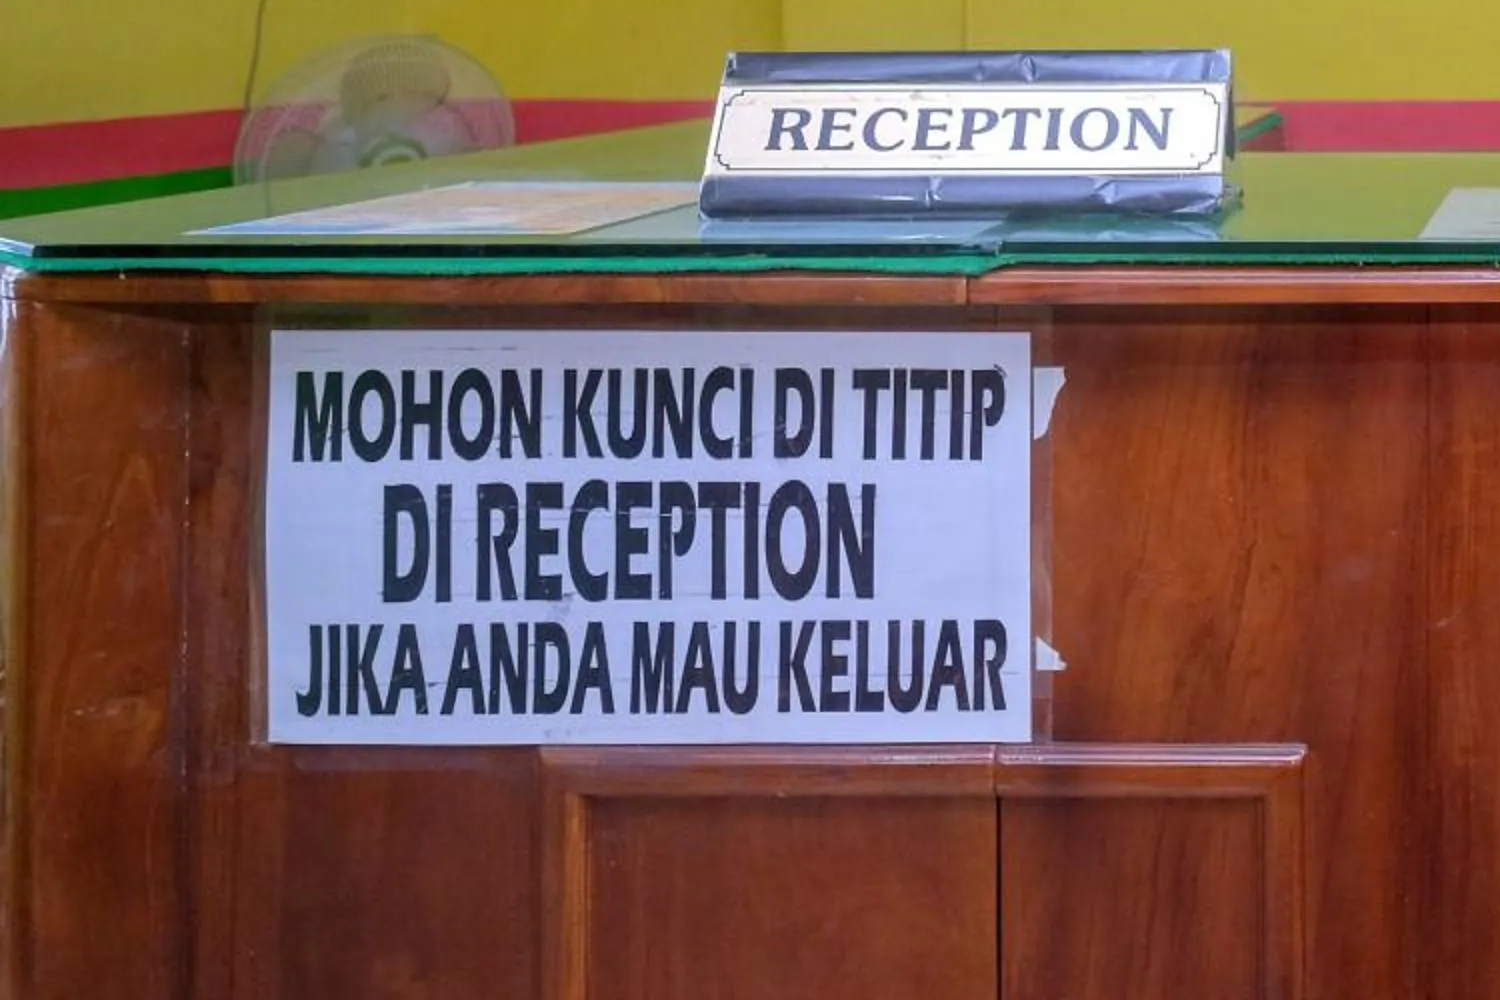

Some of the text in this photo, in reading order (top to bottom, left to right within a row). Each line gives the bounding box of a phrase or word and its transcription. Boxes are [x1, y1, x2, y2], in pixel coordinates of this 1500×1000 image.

[764, 107, 1174, 152] RECEPTION
[291, 366, 1007, 463] MOHON KUNCI DI TITIP
[382, 479, 877, 603] DI RECEPTION
[295, 619, 1008, 717] JIKA ANDA MAU KELUAR
